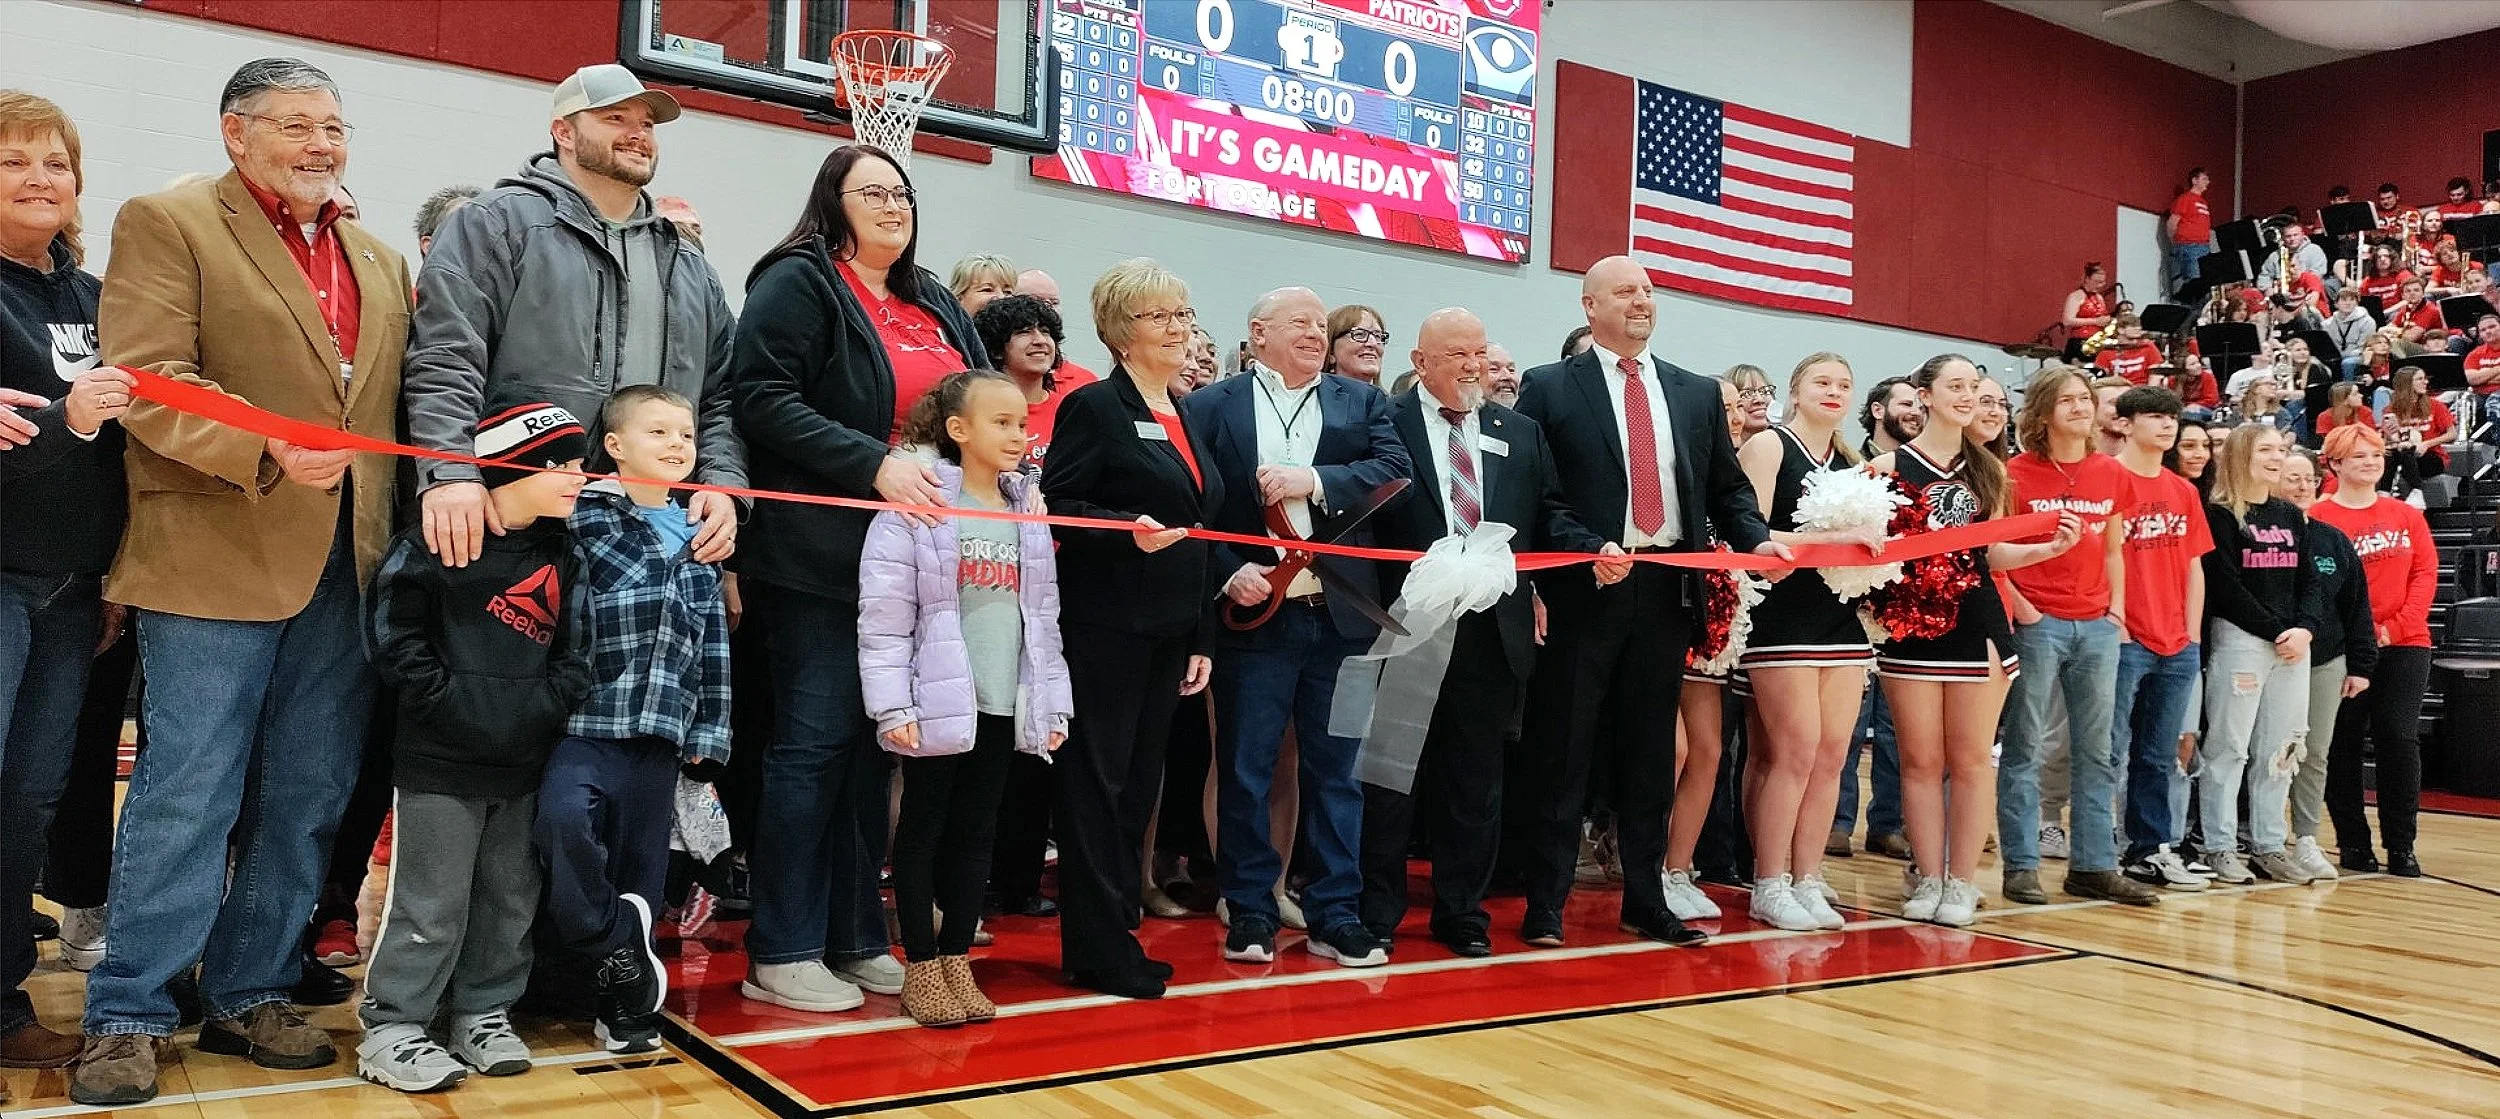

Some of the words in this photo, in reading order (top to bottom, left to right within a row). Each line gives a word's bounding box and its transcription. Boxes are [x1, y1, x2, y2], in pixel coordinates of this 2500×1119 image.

[1083, 6, 1108, 20] PTS
[1292, 16, 1332, 33] PERIOD
[1369, 0, 1459, 37] PATRIOTS
[1089, 24, 1101, 40] 0
[1119, 31, 1129, 47] 0
[1196, 0, 1234, 53] 0
[1052, 40, 1075, 63] 5
[1089, 51, 1100, 66] 0
[1118, 57, 1129, 73] 0
[1149, 44, 1196, 66] FOULS
[1301, 35, 1319, 68] 1
[1163, 64, 1180, 92] 0
[1384, 40, 1417, 97] 0
[1088, 77, 1099, 94] 0
[1117, 84, 1128, 100] 0
[1261, 75, 1355, 125] 08:00
[1087, 104, 1099, 120] 0
[1116, 110, 1127, 127] 0
[1414, 107, 1454, 125] FOULS
[1491, 104, 1511, 116] PTS
[1426, 125, 1441, 149] 0
[1496, 119, 1505, 133] 0
[1517, 124, 1526, 138] 0
[1086, 131, 1098, 147] 0
[1115, 136, 1127, 152] 0
[1465, 135, 1485, 156] 32
[1495, 142, 1504, 156] 0
[1517, 147, 1525, 161] 0
[1171, 119, 1240, 165] IT'S
[1252, 137, 1431, 201] GAMEDAY
[1494, 164, 1503, 180] 0
[1516, 169, 1525, 184] 0
[1148, 169, 1218, 199] FORT
[1227, 184, 1316, 220] OSAGE
[1463, 180, 1484, 200] 50
[1493, 188, 1502, 202] 0
[1515, 192, 1524, 207] 0
[1467, 205, 1477, 222] 1
[1492, 211, 1502, 226] 0
[1514, 215, 1523, 230] 0
[46, 323, 98, 355] NIKE
[2248, 524, 2294, 547] Lady
[2242, 547, 2298, 568] Indian
